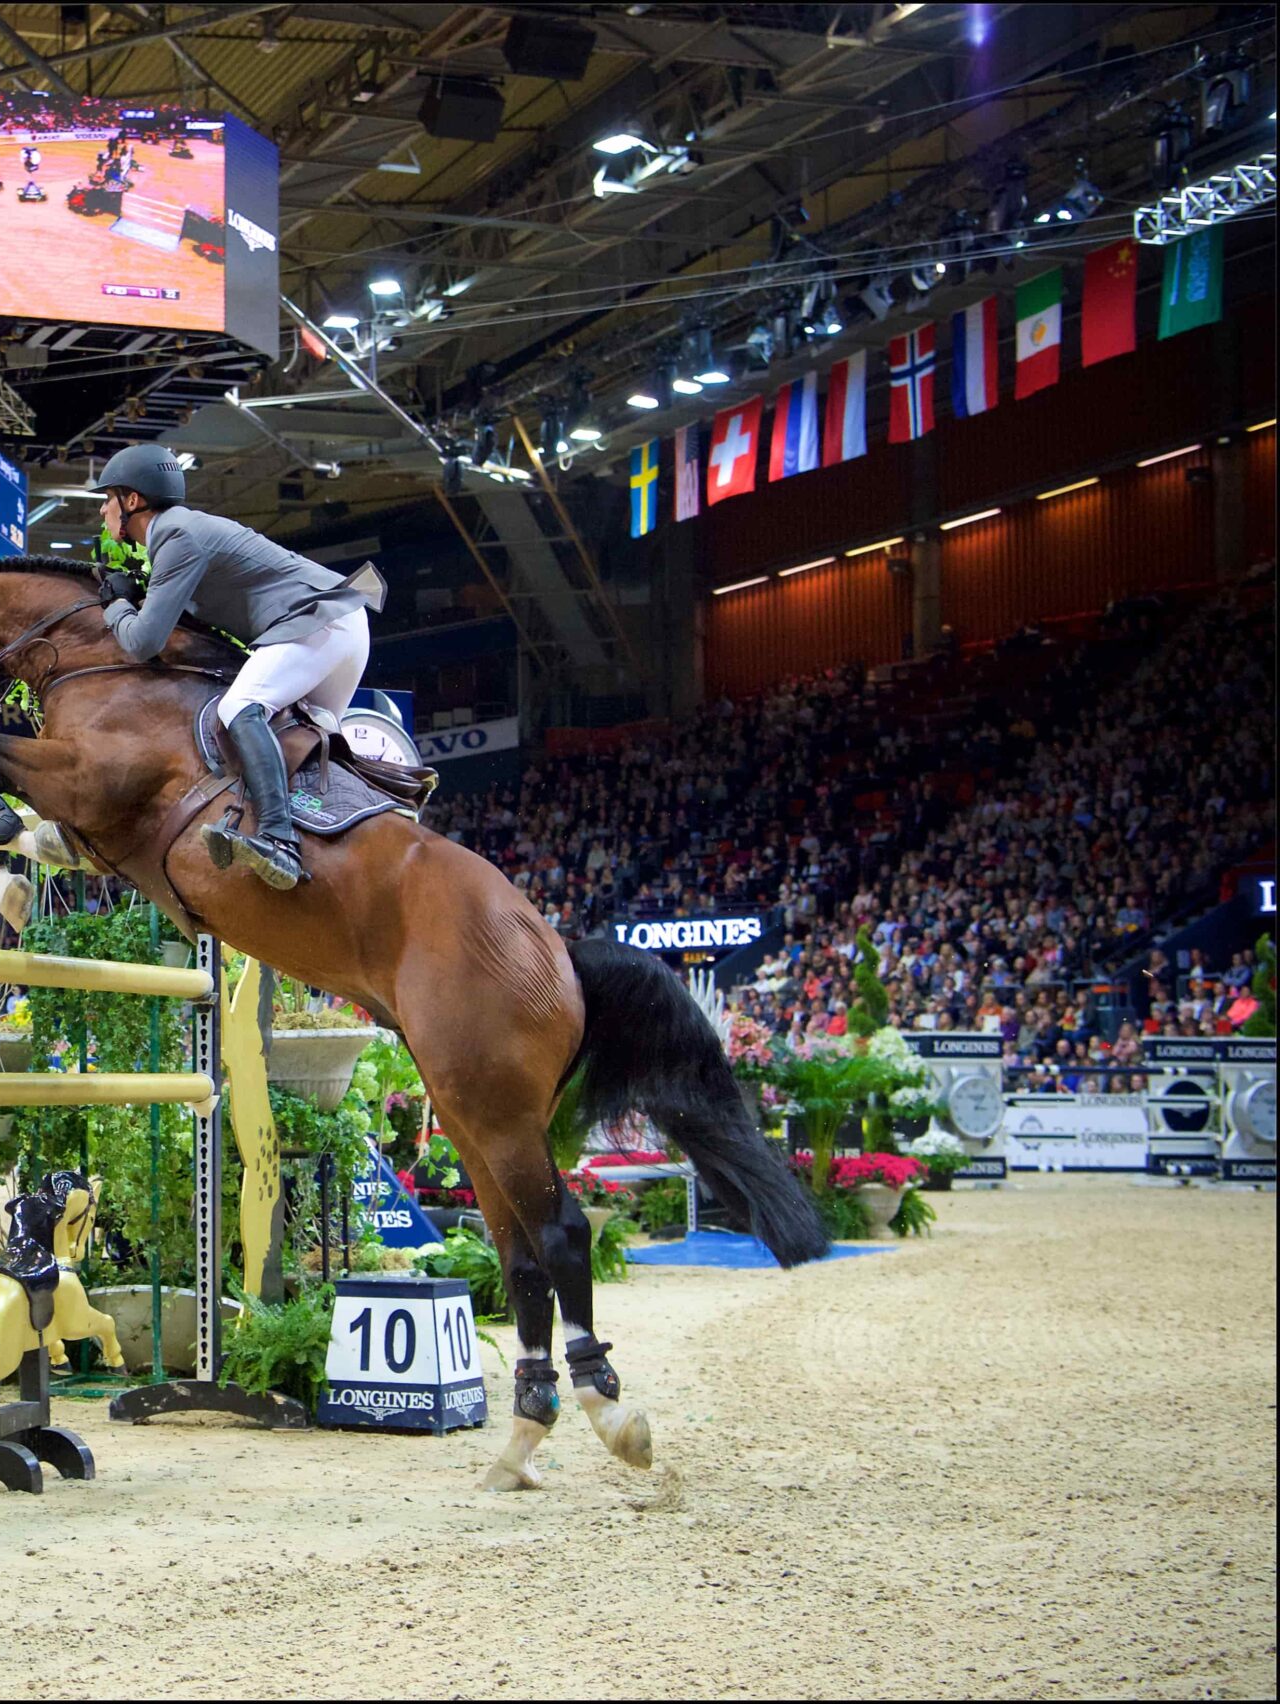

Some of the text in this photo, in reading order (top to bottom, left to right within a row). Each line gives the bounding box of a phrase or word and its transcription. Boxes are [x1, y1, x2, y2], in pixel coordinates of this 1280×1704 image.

[227, 208, 276, 252] LONGINES
[614, 918, 762, 950] LONGINES
[933, 1040, 1000, 1054] LONGINES
[349, 1307, 416, 1374] 10
[443, 1306, 471, 1372] 10
[327, 1389, 435, 1410] LONGINES
[444, 1386, 484, 1410] LONGINES
